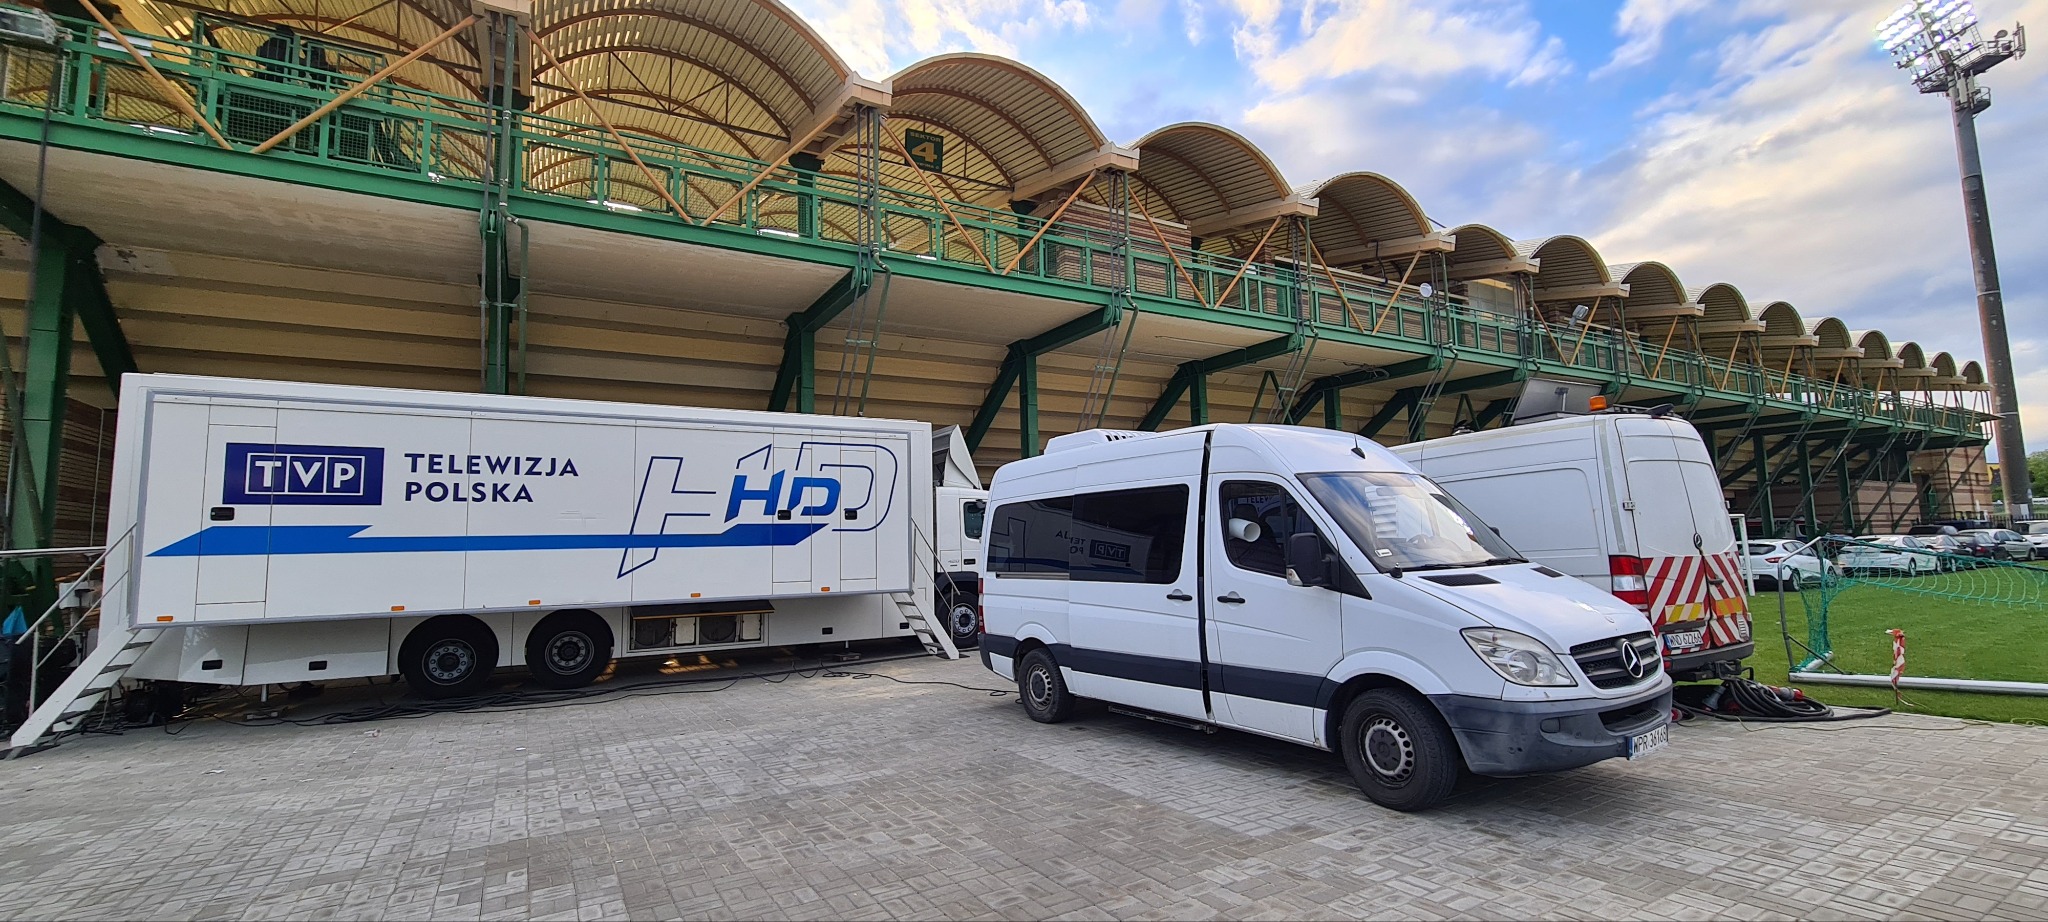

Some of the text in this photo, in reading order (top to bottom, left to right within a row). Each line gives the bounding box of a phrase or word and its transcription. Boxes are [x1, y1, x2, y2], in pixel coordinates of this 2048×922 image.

[912, 142, 937, 162] 4
[255, 461, 355, 488] TVP
[404, 453, 579, 477] TELEWIZJA
[404, 481, 533, 503] POLSKA
[724, 469, 841, 523] HD
[1633, 735, 1648, 753] WPR
